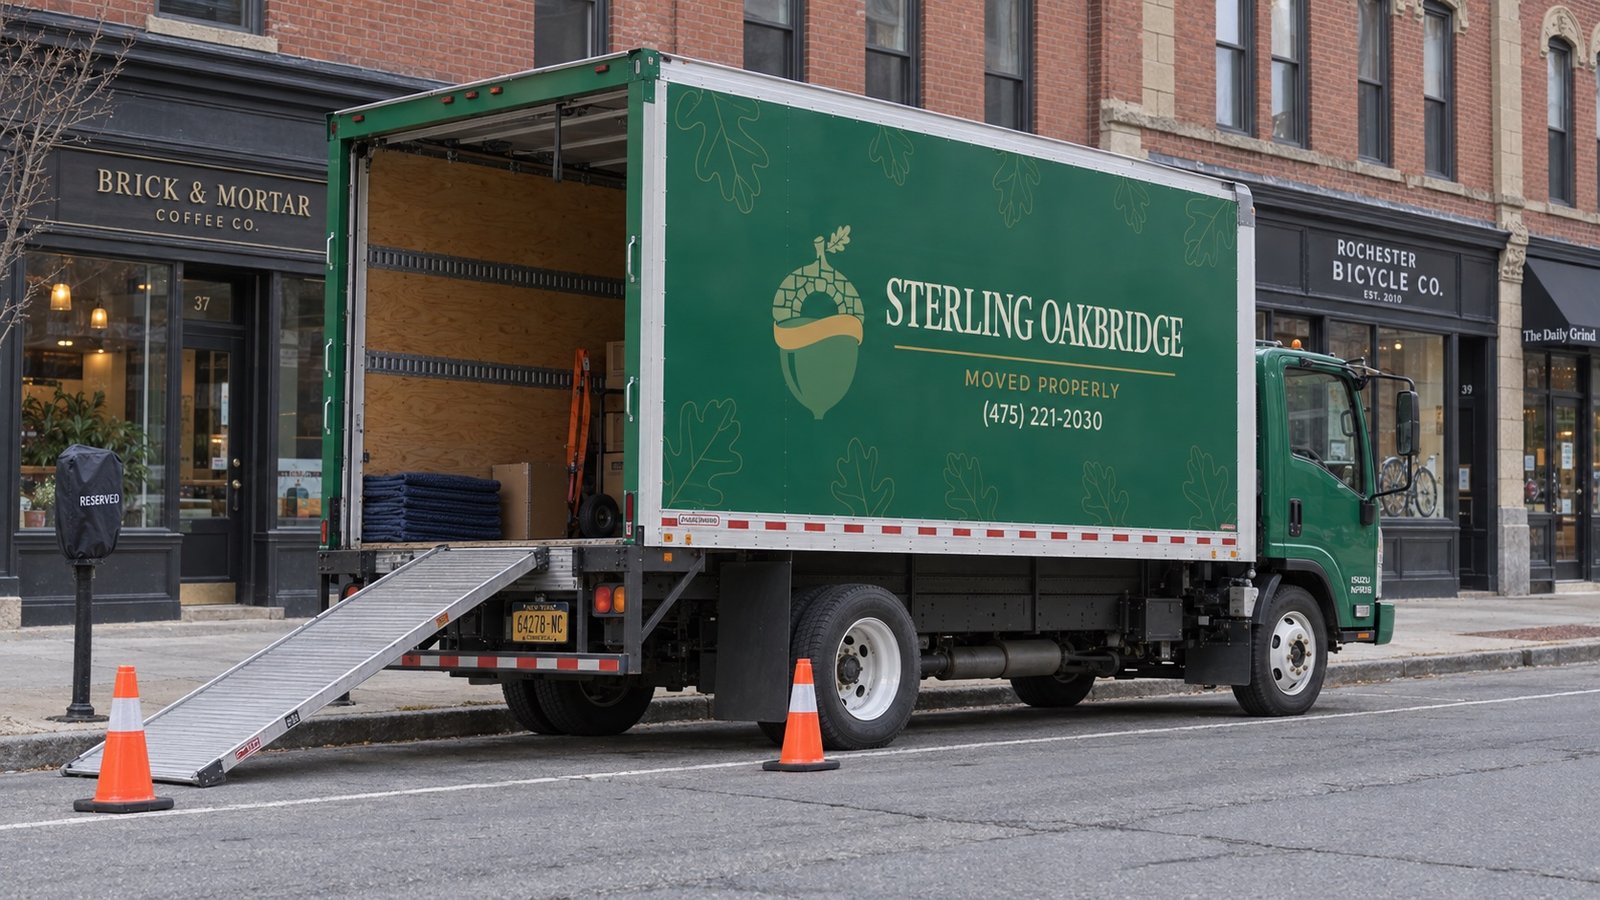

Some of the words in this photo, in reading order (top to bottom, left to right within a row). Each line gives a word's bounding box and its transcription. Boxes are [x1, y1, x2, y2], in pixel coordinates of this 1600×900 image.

[97, 168, 180, 201] BRICK
[189, 181, 207, 204] &
[216, 184, 311, 217] MORTAR
[156, 208, 224, 228] COFFEE
[232, 217, 259, 232] CO.
[1337, 239, 1416, 268] ROCHESTER
[1333, 260, 1408, 291] BICYCLE
[1417, 275, 1443, 296] CO.
[194, 296, 210, 311] 37
[1363, 290, 1381, 300] EST.
[1383, 292, 1402, 304] 2010
[886, 277, 1034, 341] STERLING
[1041, 299, 1184, 358] OAKBRIDGE
[1523, 329, 1541, 342] The
[1543, 328, 1568, 343] Daily
[1569, 327, 1596, 342] Grind
[965, 369, 1031, 391] MOVED
[1038, 376, 1120, 399] PROPERLY
[1461, 384, 1473, 394] 39
[983, 400, 1025, 430] (475)
[1030, 406, 1103, 431] 221-2030
[80, 493, 120, 507] RESERVED
[1351, 576, 1371, 584] ISUZU
[517, 614, 563, 634] 64278-NC
